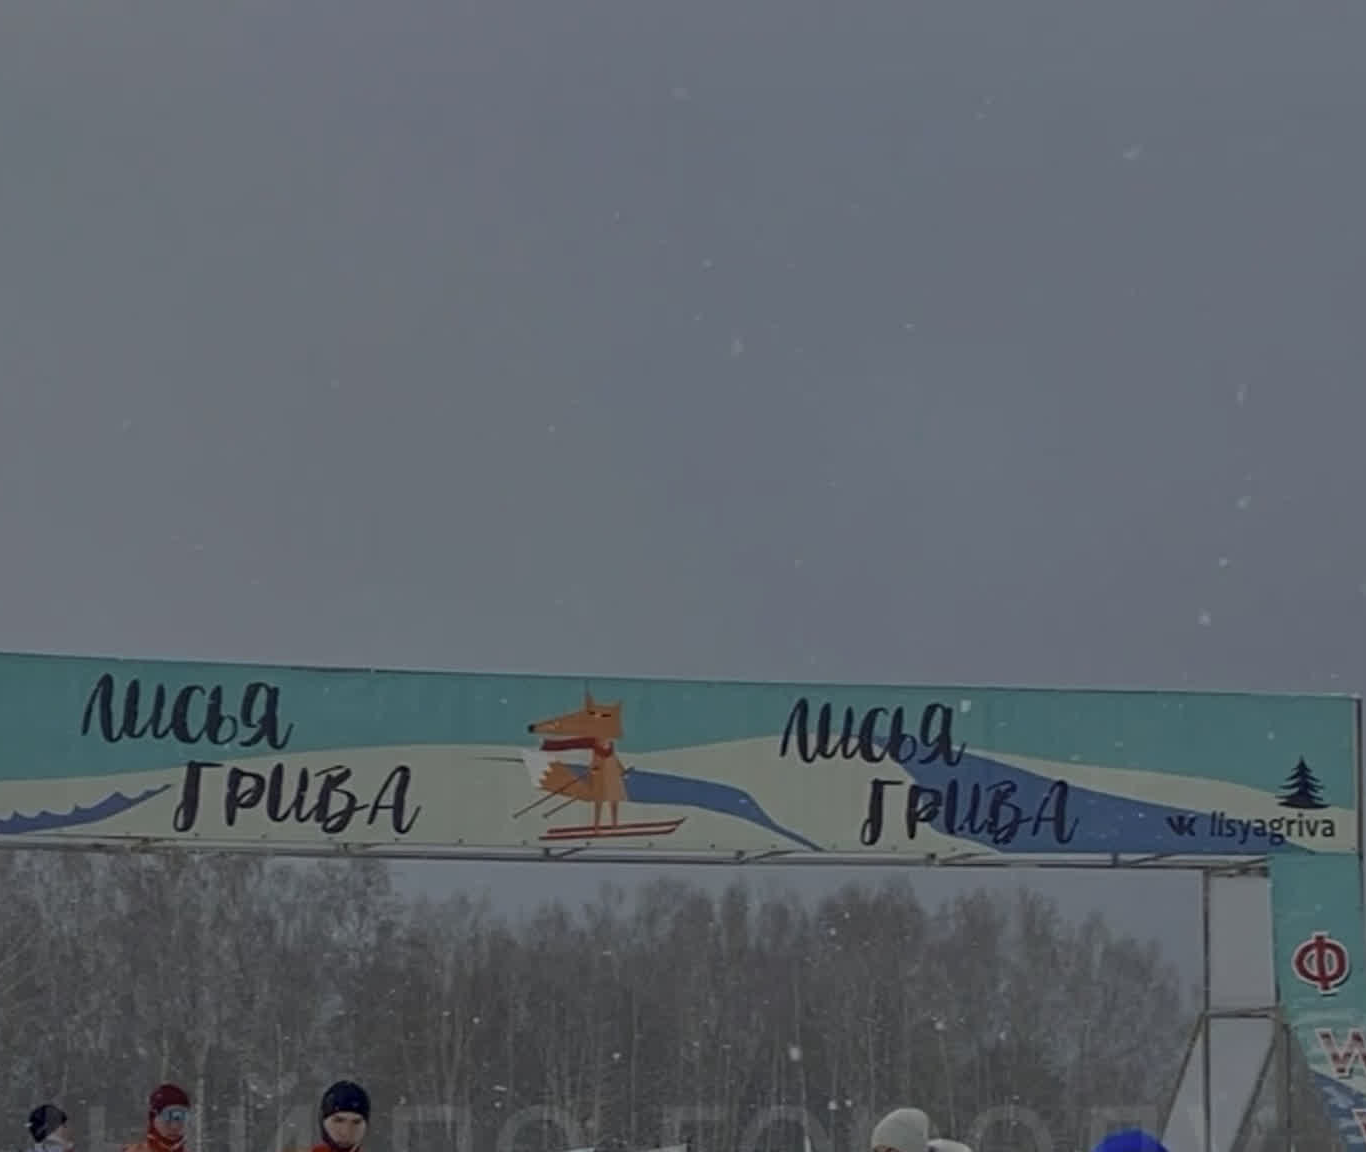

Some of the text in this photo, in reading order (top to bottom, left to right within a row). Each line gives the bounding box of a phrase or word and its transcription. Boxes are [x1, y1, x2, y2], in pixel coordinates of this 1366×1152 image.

[173, 761, 422, 836] ГРИВА
[859, 779, 1084, 846] ГРИВА
[1208, 812, 1337, 845] lisyagriva
